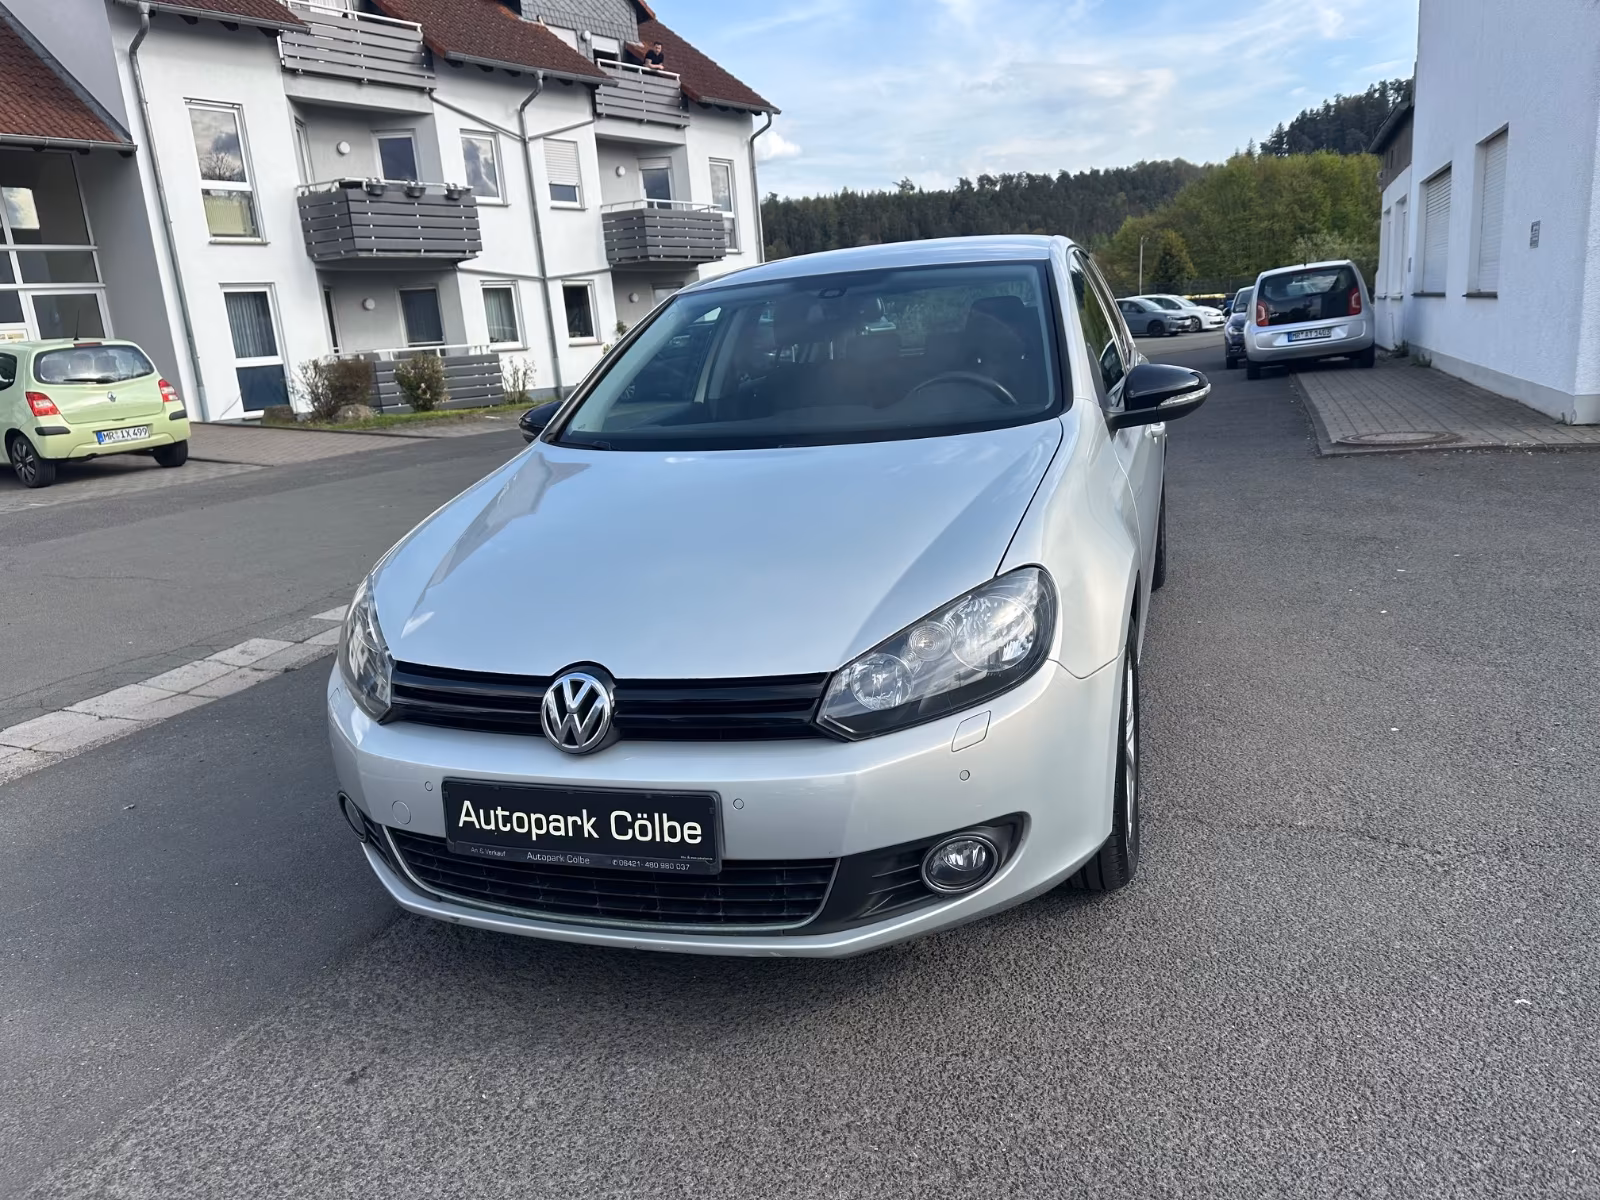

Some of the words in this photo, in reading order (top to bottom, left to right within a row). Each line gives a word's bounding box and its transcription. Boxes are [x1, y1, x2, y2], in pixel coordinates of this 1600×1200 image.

[102, 431, 116, 441] MR
[132, 427, 148, 437] 499
[458, 799, 600, 841] Autopark
[609, 809, 703, 845] Cölbe
[485, 848, 506, 857] Verkauf
[526, 851, 565, 863] Autopark
[566, 853, 590, 865] Cölbe
